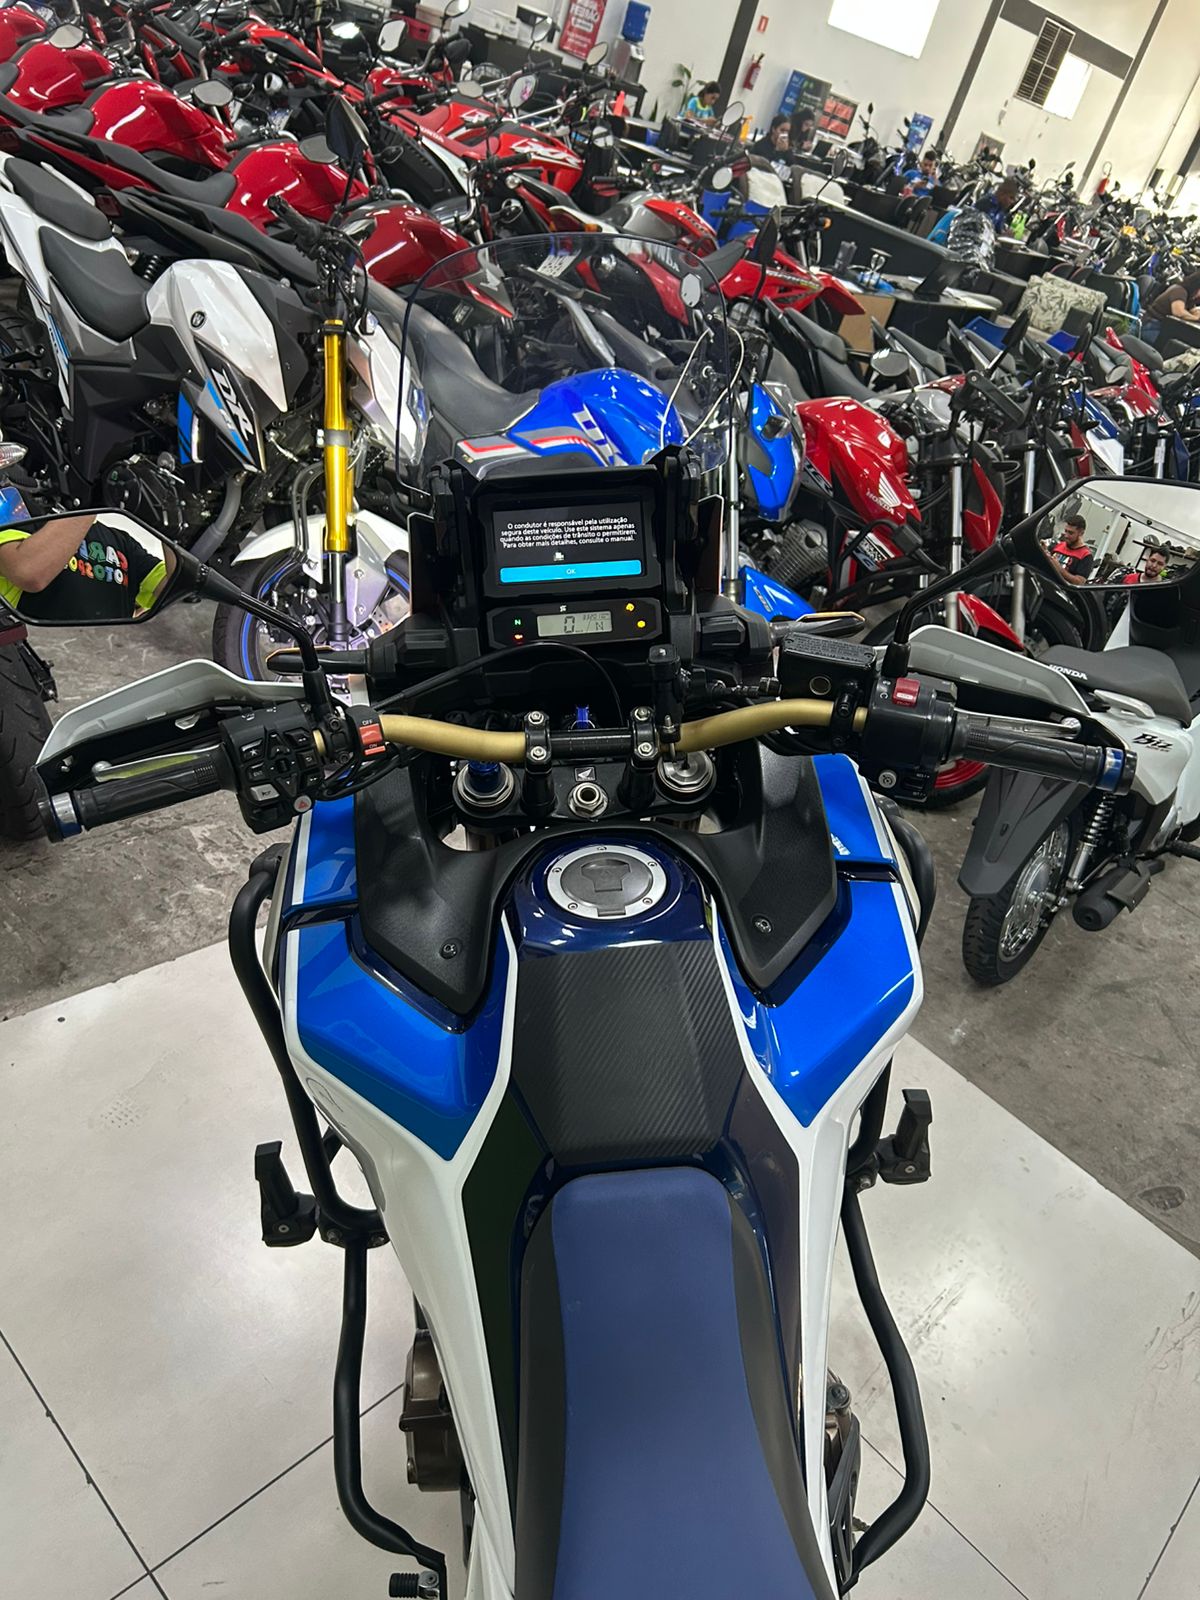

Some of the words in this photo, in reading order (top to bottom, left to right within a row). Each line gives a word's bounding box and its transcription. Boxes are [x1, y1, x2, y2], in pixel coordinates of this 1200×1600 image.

[866, 488, 895, 515] HONDA
[548, 519, 584, 528] responsável
[585, 518, 597, 526] pela
[598, 517, 628, 525] utilização
[564, 616, 575, 633] 0
[595, 621, 604, 631] N
[1133, 733, 1173, 748] Biz
